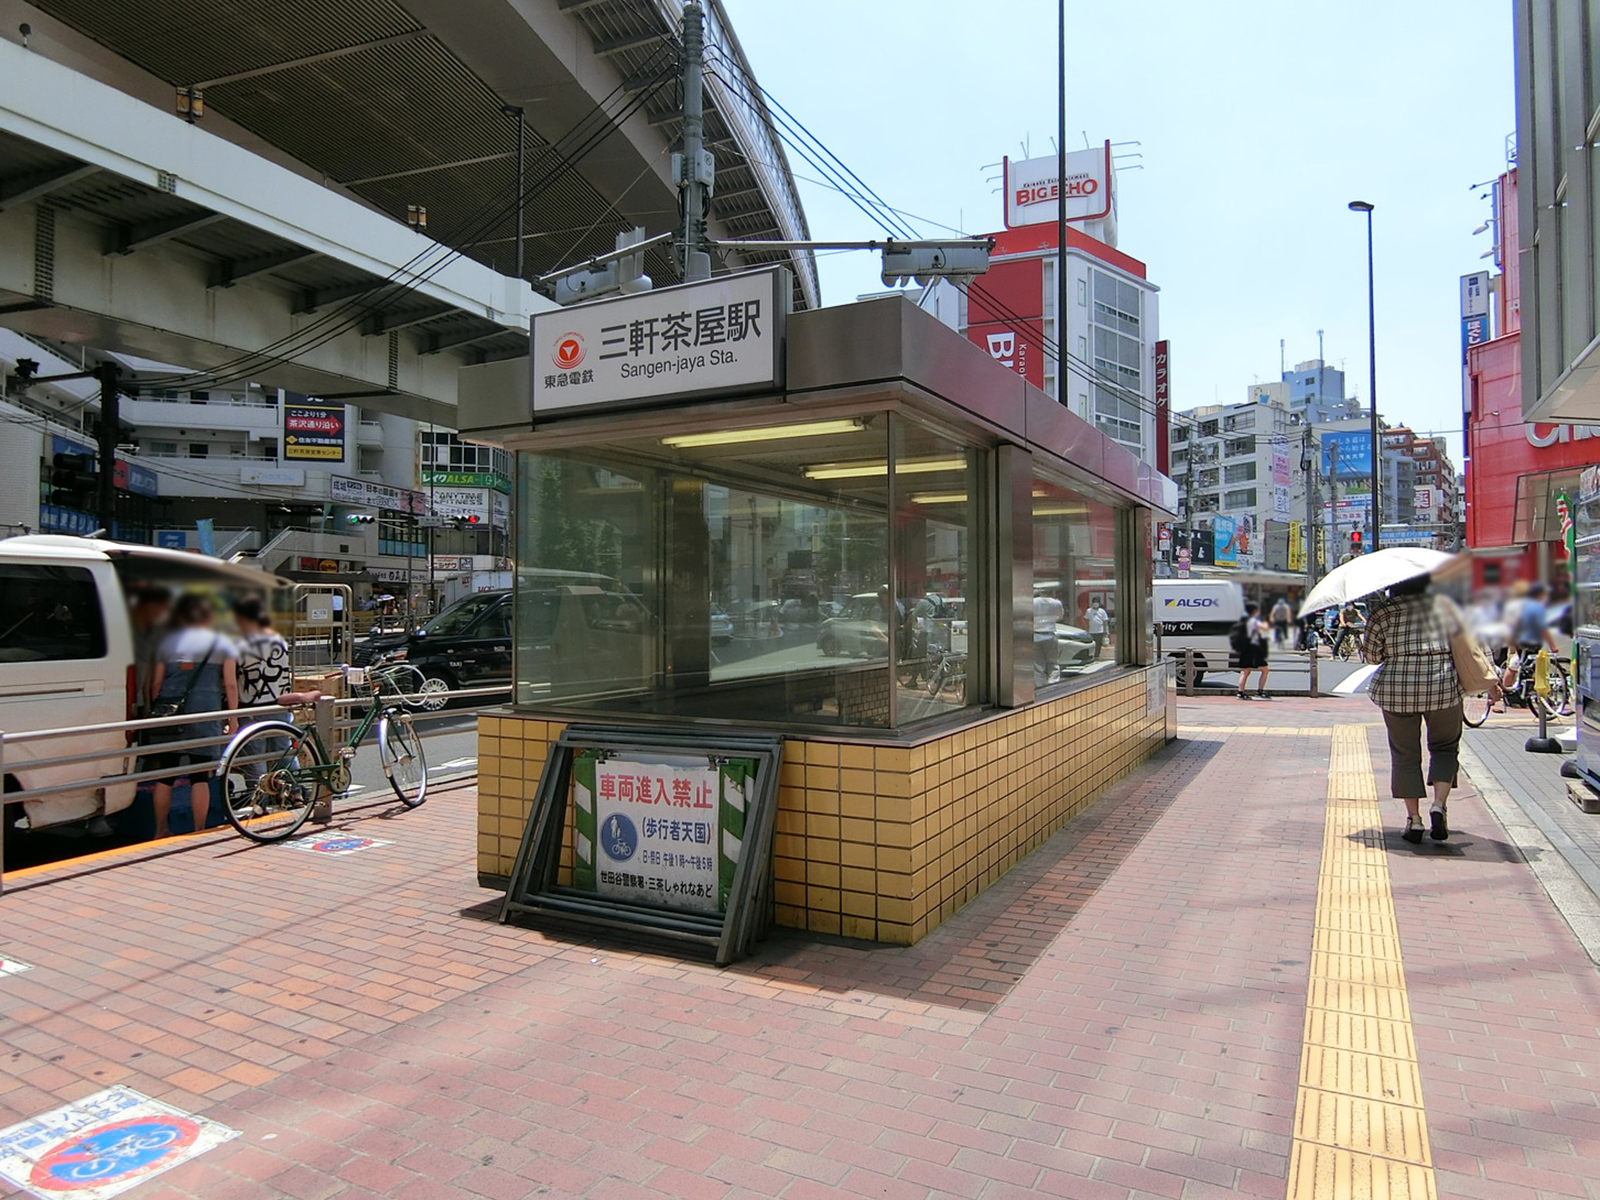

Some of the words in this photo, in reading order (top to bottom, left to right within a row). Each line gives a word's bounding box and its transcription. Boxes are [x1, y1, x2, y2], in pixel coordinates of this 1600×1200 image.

[1015, 186, 1047, 206] BIG
[1050, 178, 1098, 197] EHO
[598, 299, 762, 360] 三軒茶屋駅
[620, 353, 706, 379] Sangen-jaya
[709, 349, 739, 366] Sta.
[544, 369, 594, 389] 東急電鉄
[1156, 353, 1168, 408] カラオケ
[289, 419, 339, 429] 茶沢通り沿い
[291, 410, 327, 418] ここより1分
[422, 472, 475, 484] レイクALSA
[439, 491, 484, 500] ANYTIME
[1176, 598, 1219, 608] ALSOK
[1179, 622, 1194, 631] OK
[600, 773, 713, 809] 車両進入禁止
[642, 817, 711, 845] (歩行者天国)
